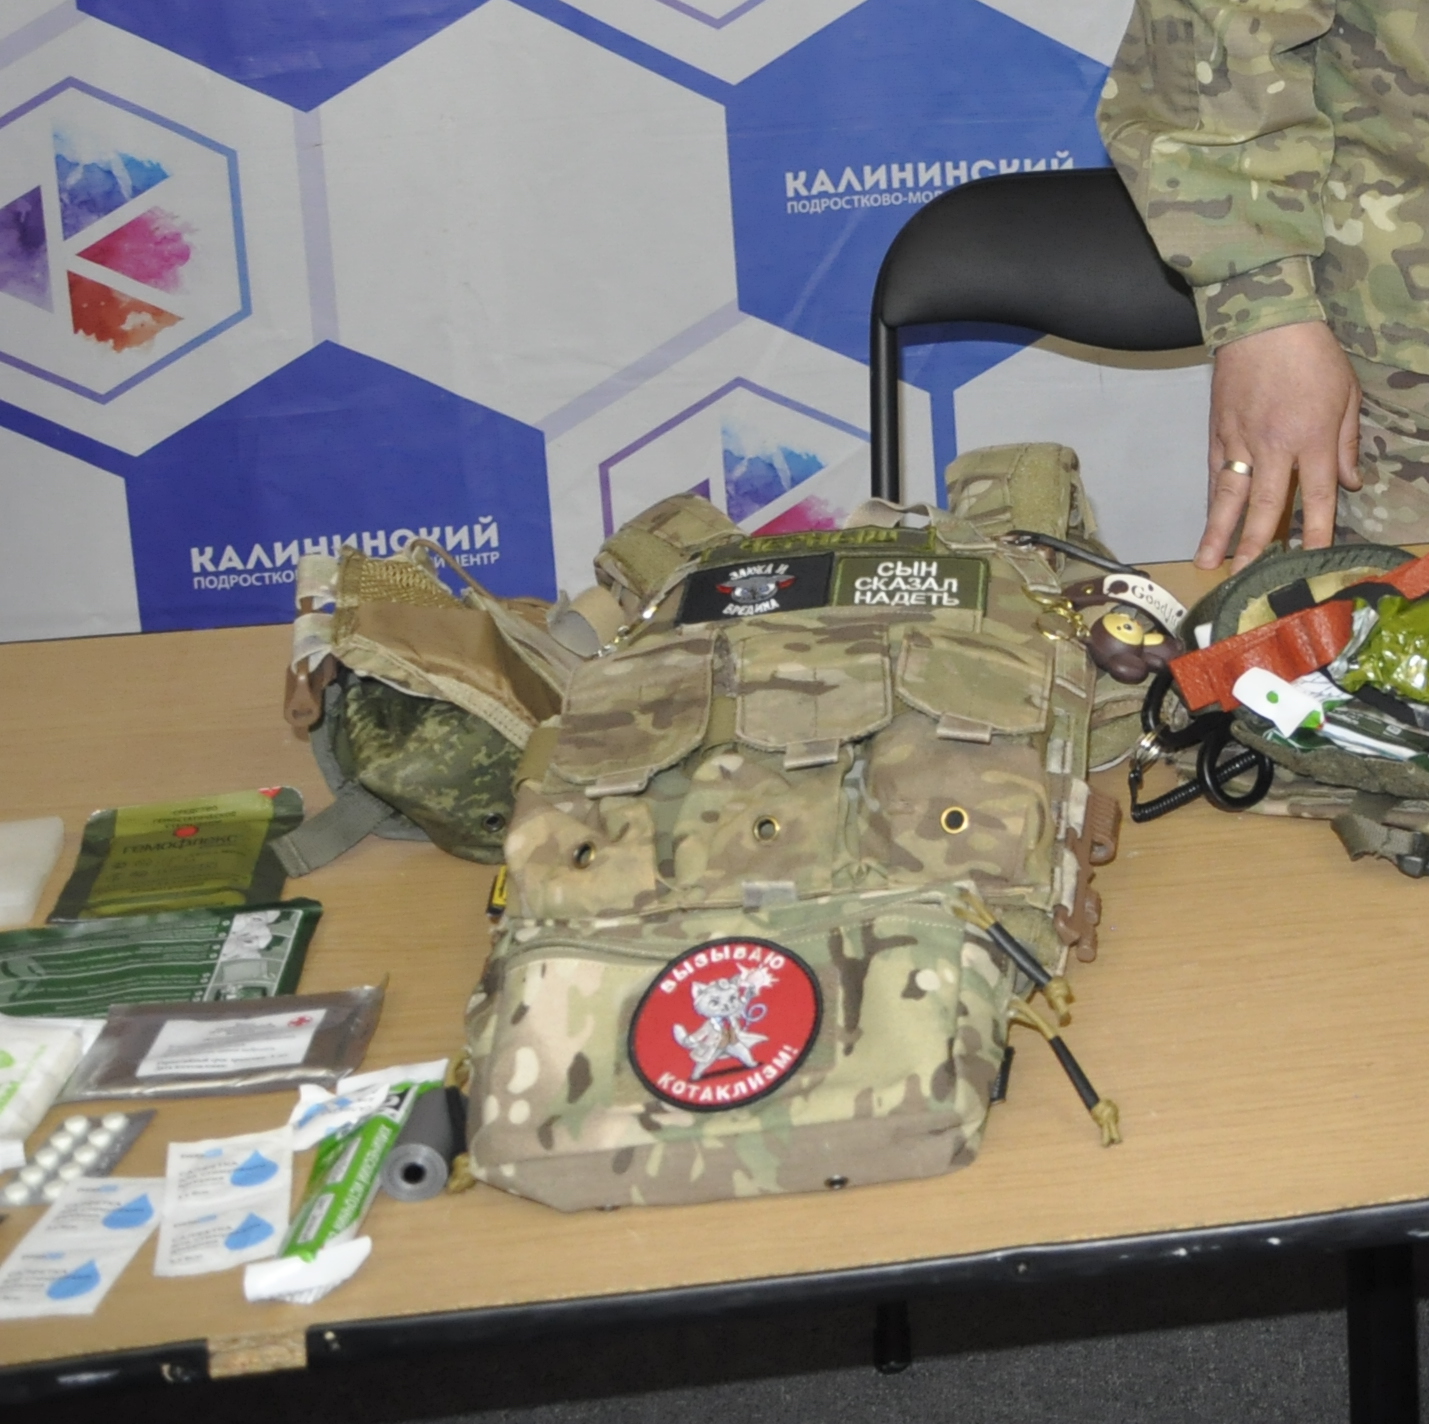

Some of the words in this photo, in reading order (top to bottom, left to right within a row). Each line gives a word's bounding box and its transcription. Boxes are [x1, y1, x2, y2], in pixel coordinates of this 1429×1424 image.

[453, 551, 500, 568] ЕНТР
[877, 560, 938, 577] СЫН
[854, 576, 958, 593] СКАЗАЛ
[722, 598, 780, 616] ВРЕДИНА
[854, 590, 960, 607] НАДЕТЬ
[659, 945, 786, 994] ВЫЗЫВАЮ
[656, 1044, 799, 1102] КОТАКЛИЗМ!
